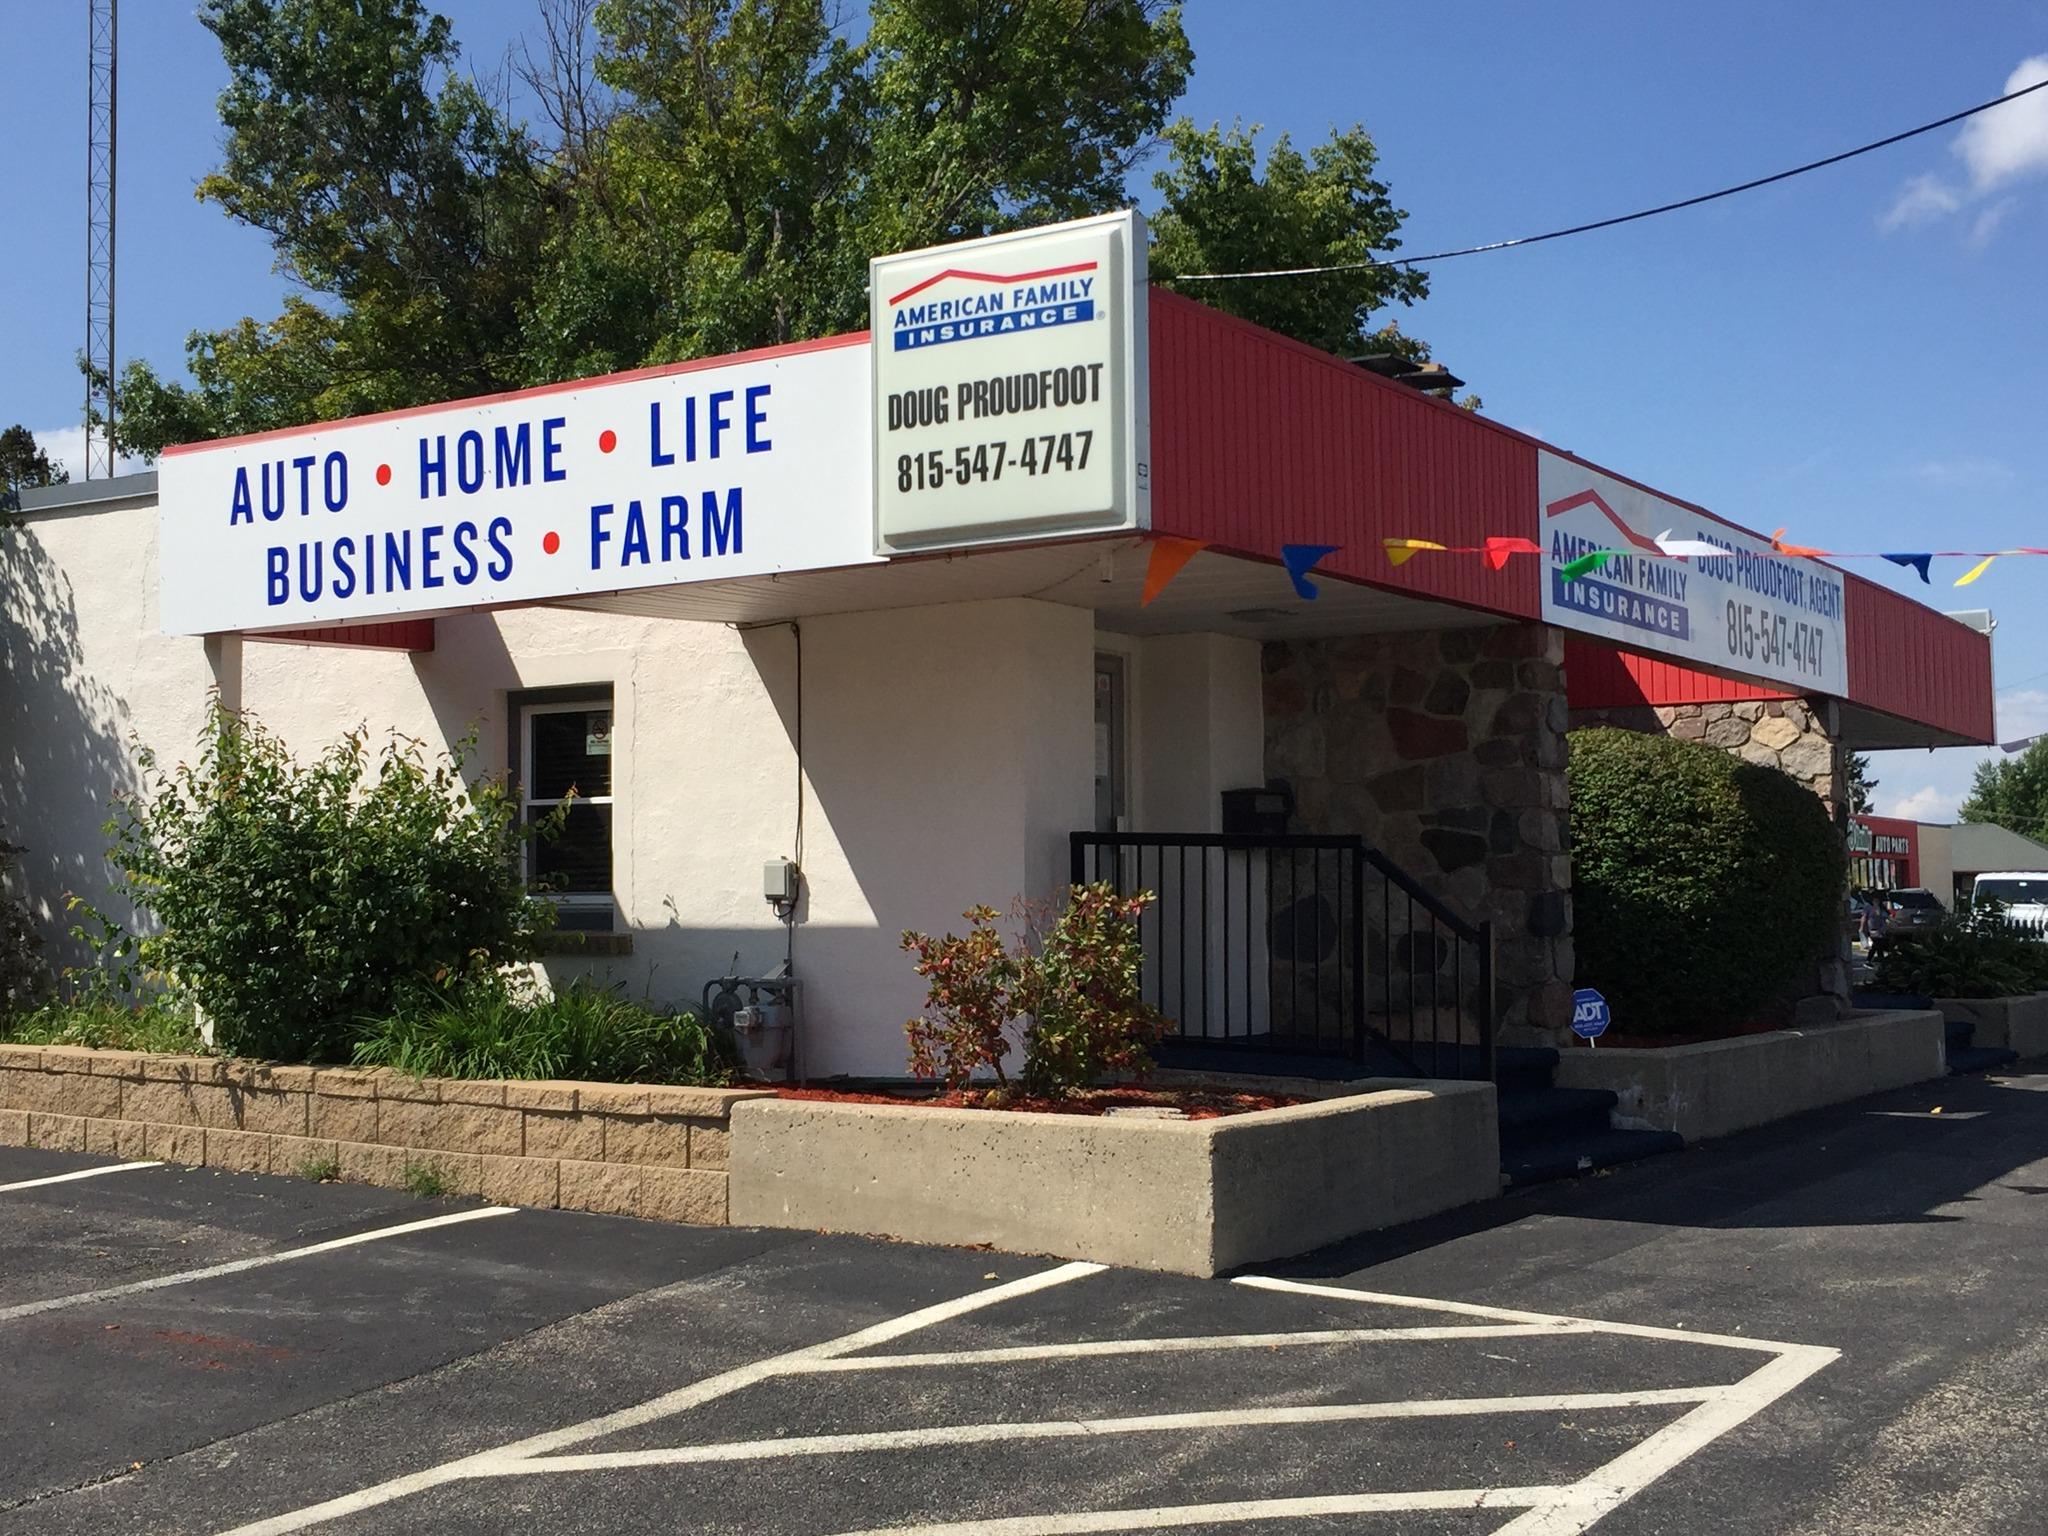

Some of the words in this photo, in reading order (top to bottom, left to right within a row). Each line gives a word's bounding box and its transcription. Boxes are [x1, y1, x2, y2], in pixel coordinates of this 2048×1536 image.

[895, 293, 1004, 328] AMERICAN
[1013, 277, 1094, 308] FAMILY
[908, 306, 1077, 346] INSURANCE
[888, 386, 949, 431] DOUG
[957, 362, 1104, 421] PROUDFOOT
[230, 450, 348, 526] AUTO
[419, 416, 567, 499] HOME
[650, 384, 772, 468] LIFE
[897, 430, 1094, 493] 815-547-4747
[267, 516, 513, 606] BUSINESS
[590, 487, 743, 571] FARM
[1697, 531, 1733, 583] DOUG
[1809, 575, 1841, 621] AGENT
[1563, 582, 1680, 632] INSURANCE
[1639, 559, 1687, 601] FAMILY
[1727, 599, 1823, 676] 815-547-4747
[1573, 1001, 1604, 1023] ADT
